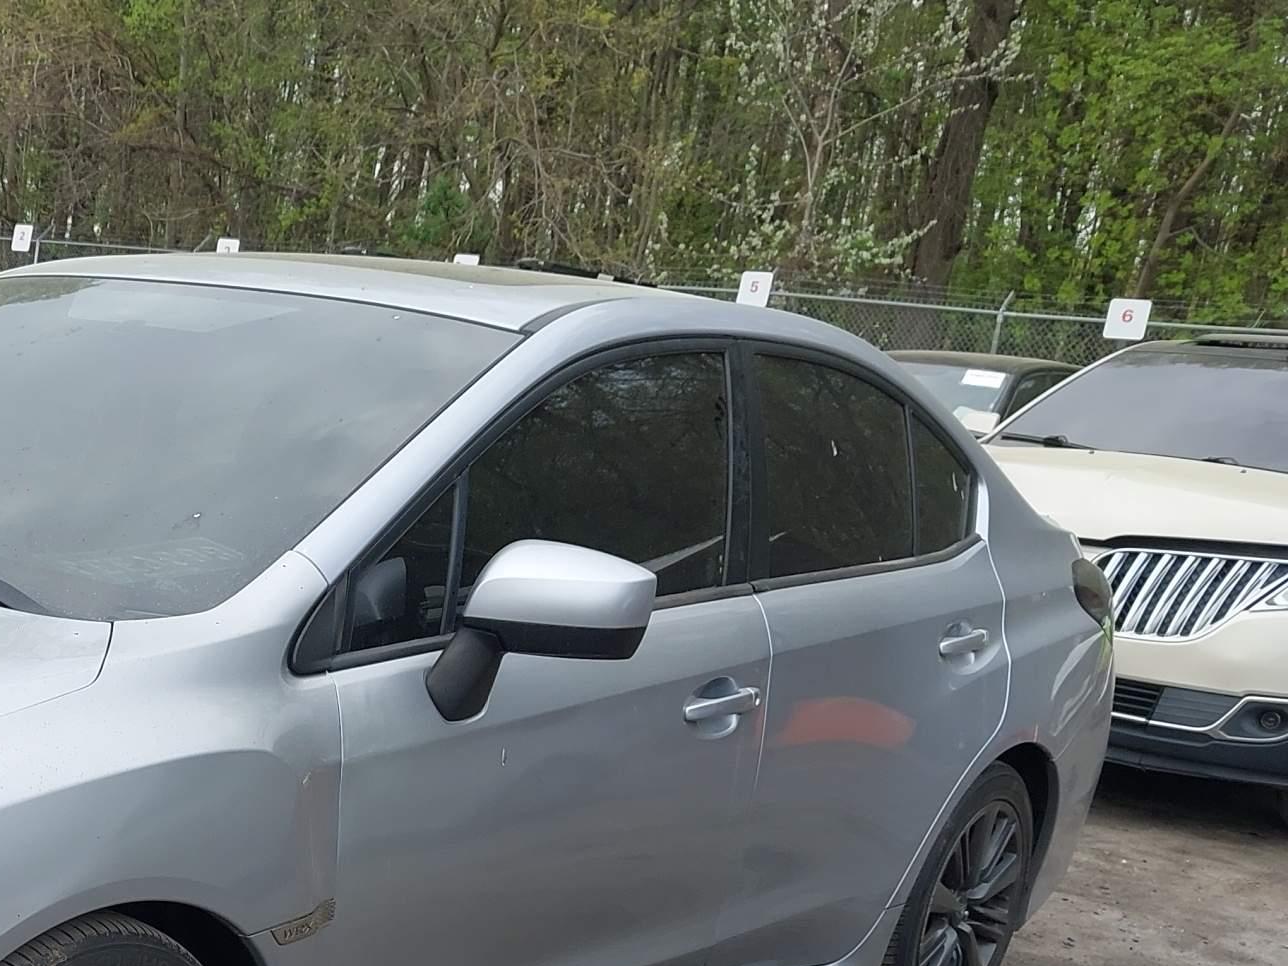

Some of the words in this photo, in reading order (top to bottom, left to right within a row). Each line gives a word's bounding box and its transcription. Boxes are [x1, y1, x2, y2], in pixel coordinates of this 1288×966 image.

[19, 231, 26, 241] 2
[750, 280, 760, 293] 5
[1122, 309, 1134, 323] 6
